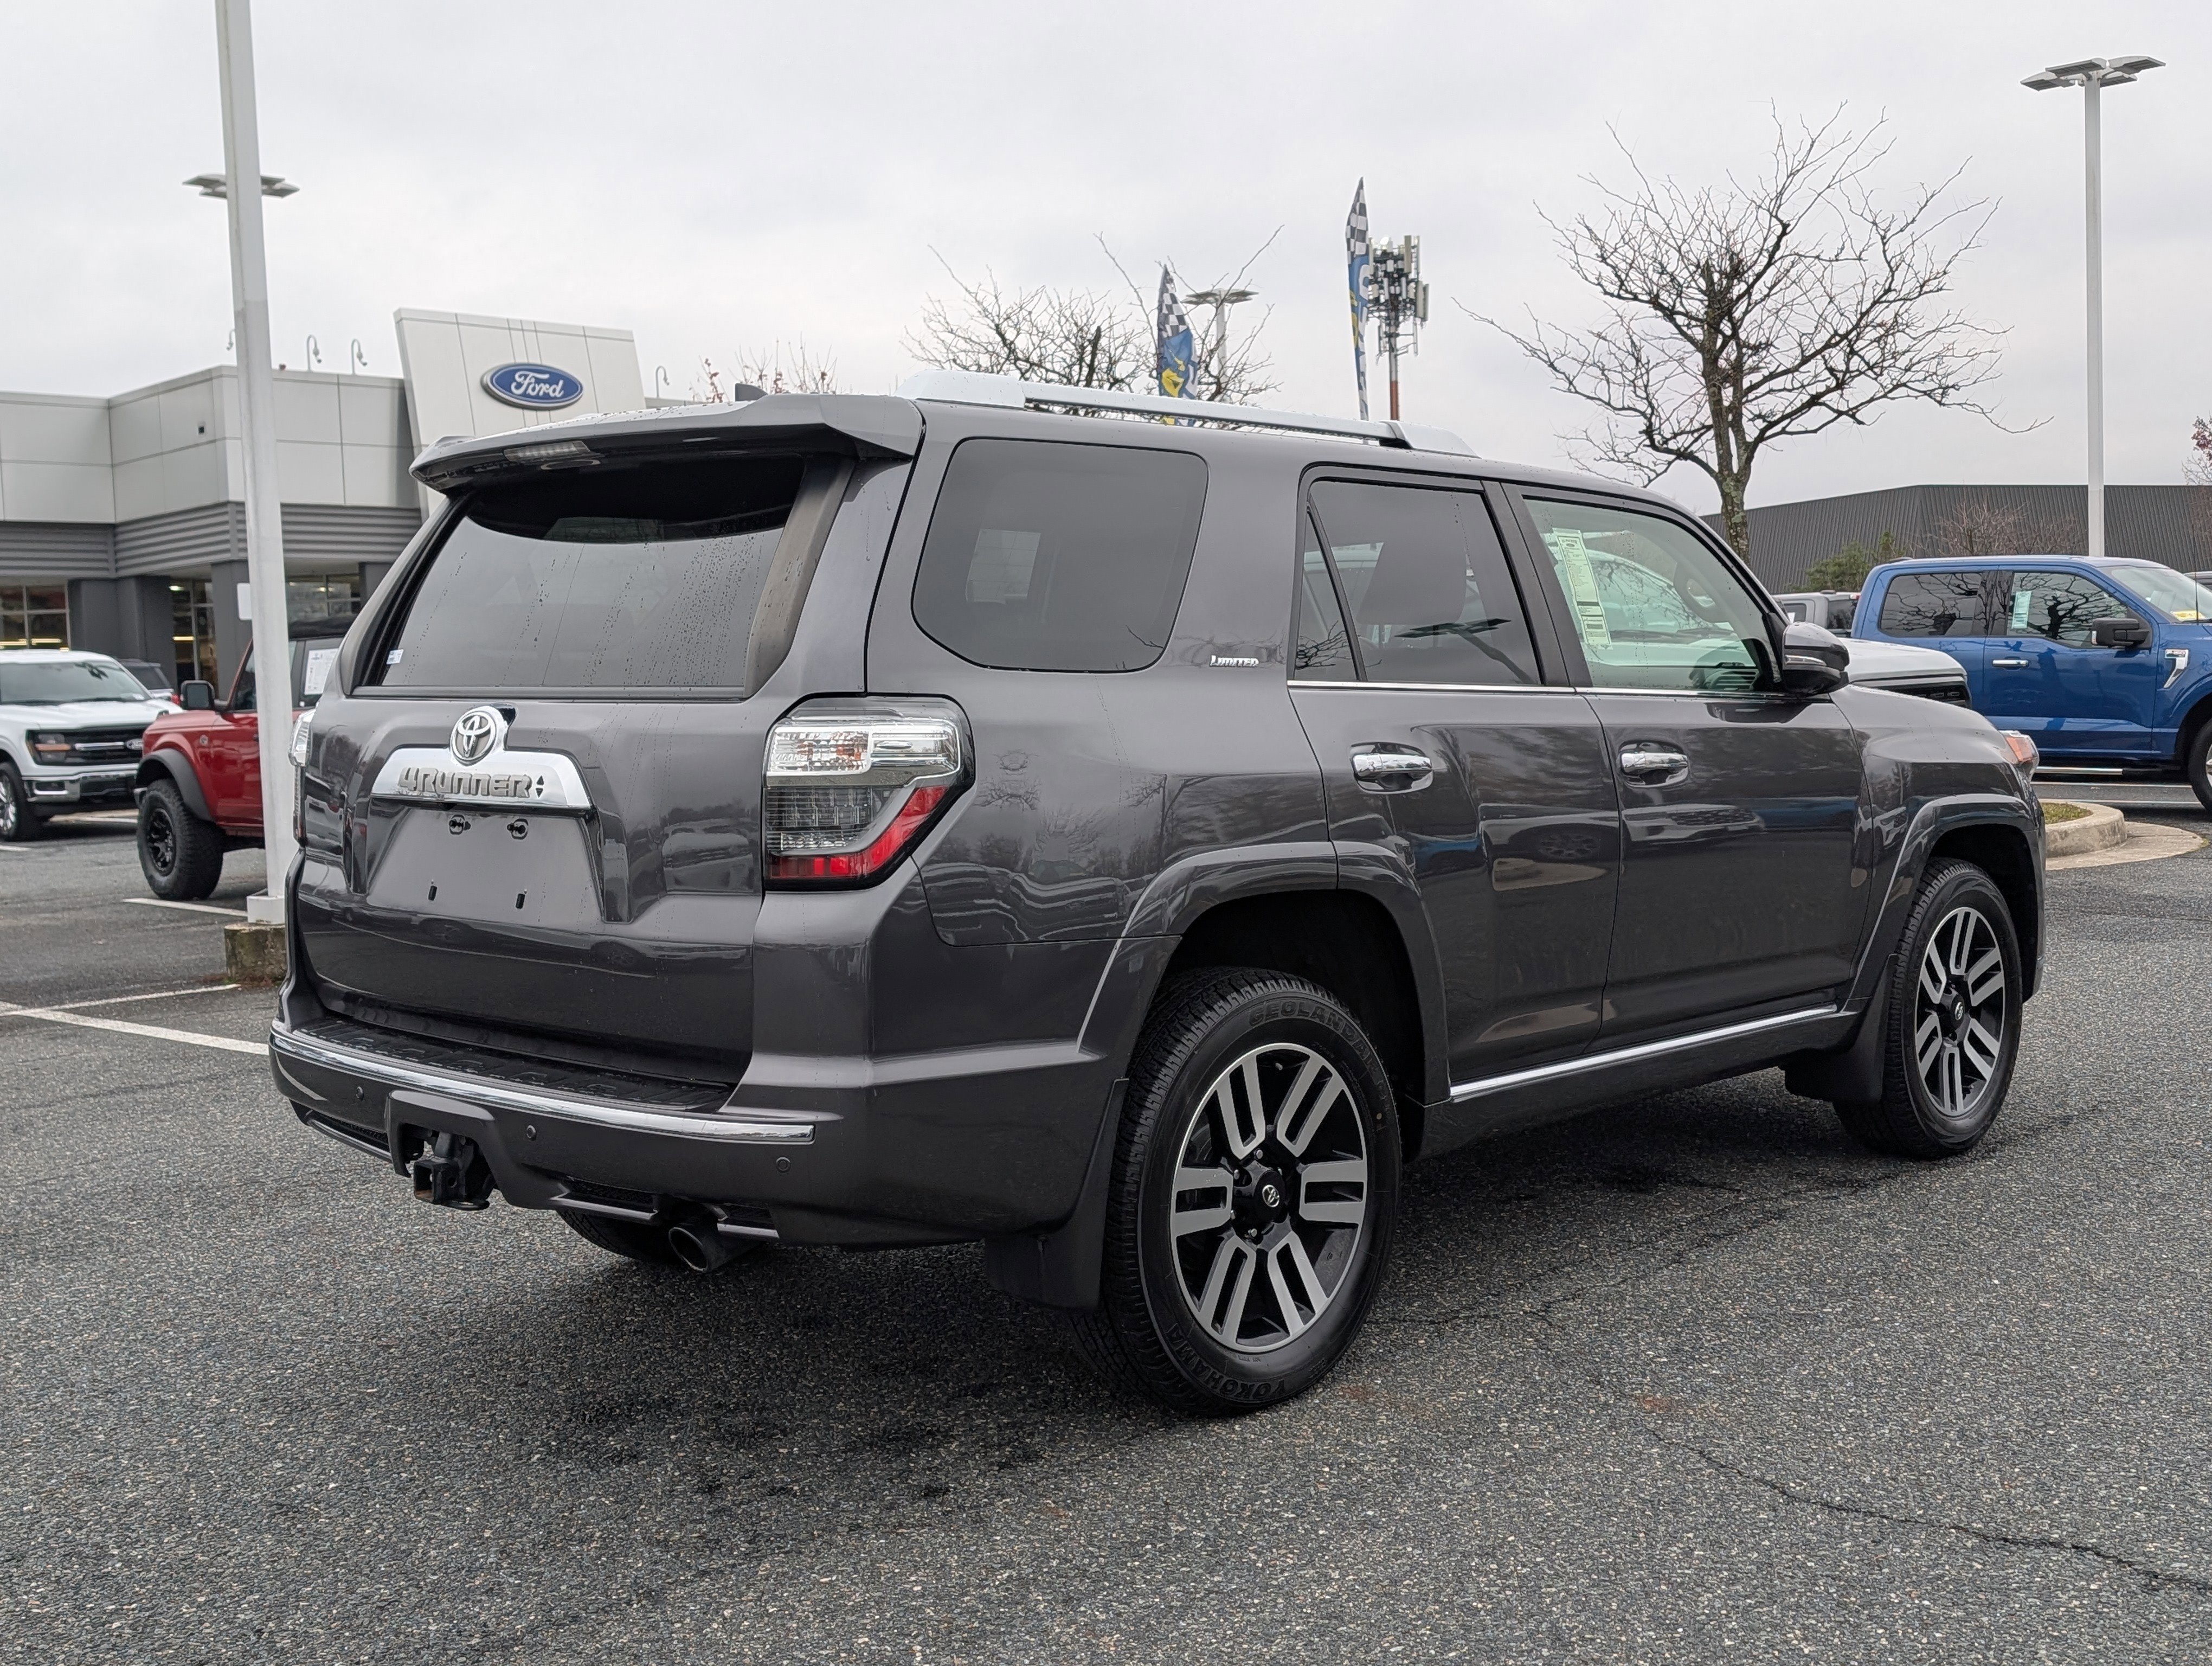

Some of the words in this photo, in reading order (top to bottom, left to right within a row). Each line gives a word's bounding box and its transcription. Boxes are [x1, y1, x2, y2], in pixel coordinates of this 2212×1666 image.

[511, 370, 564, 398] Ford
[397, 767, 532, 798] 4RUNNER
[1166, 1323, 1285, 1399] YOKOHAMA
